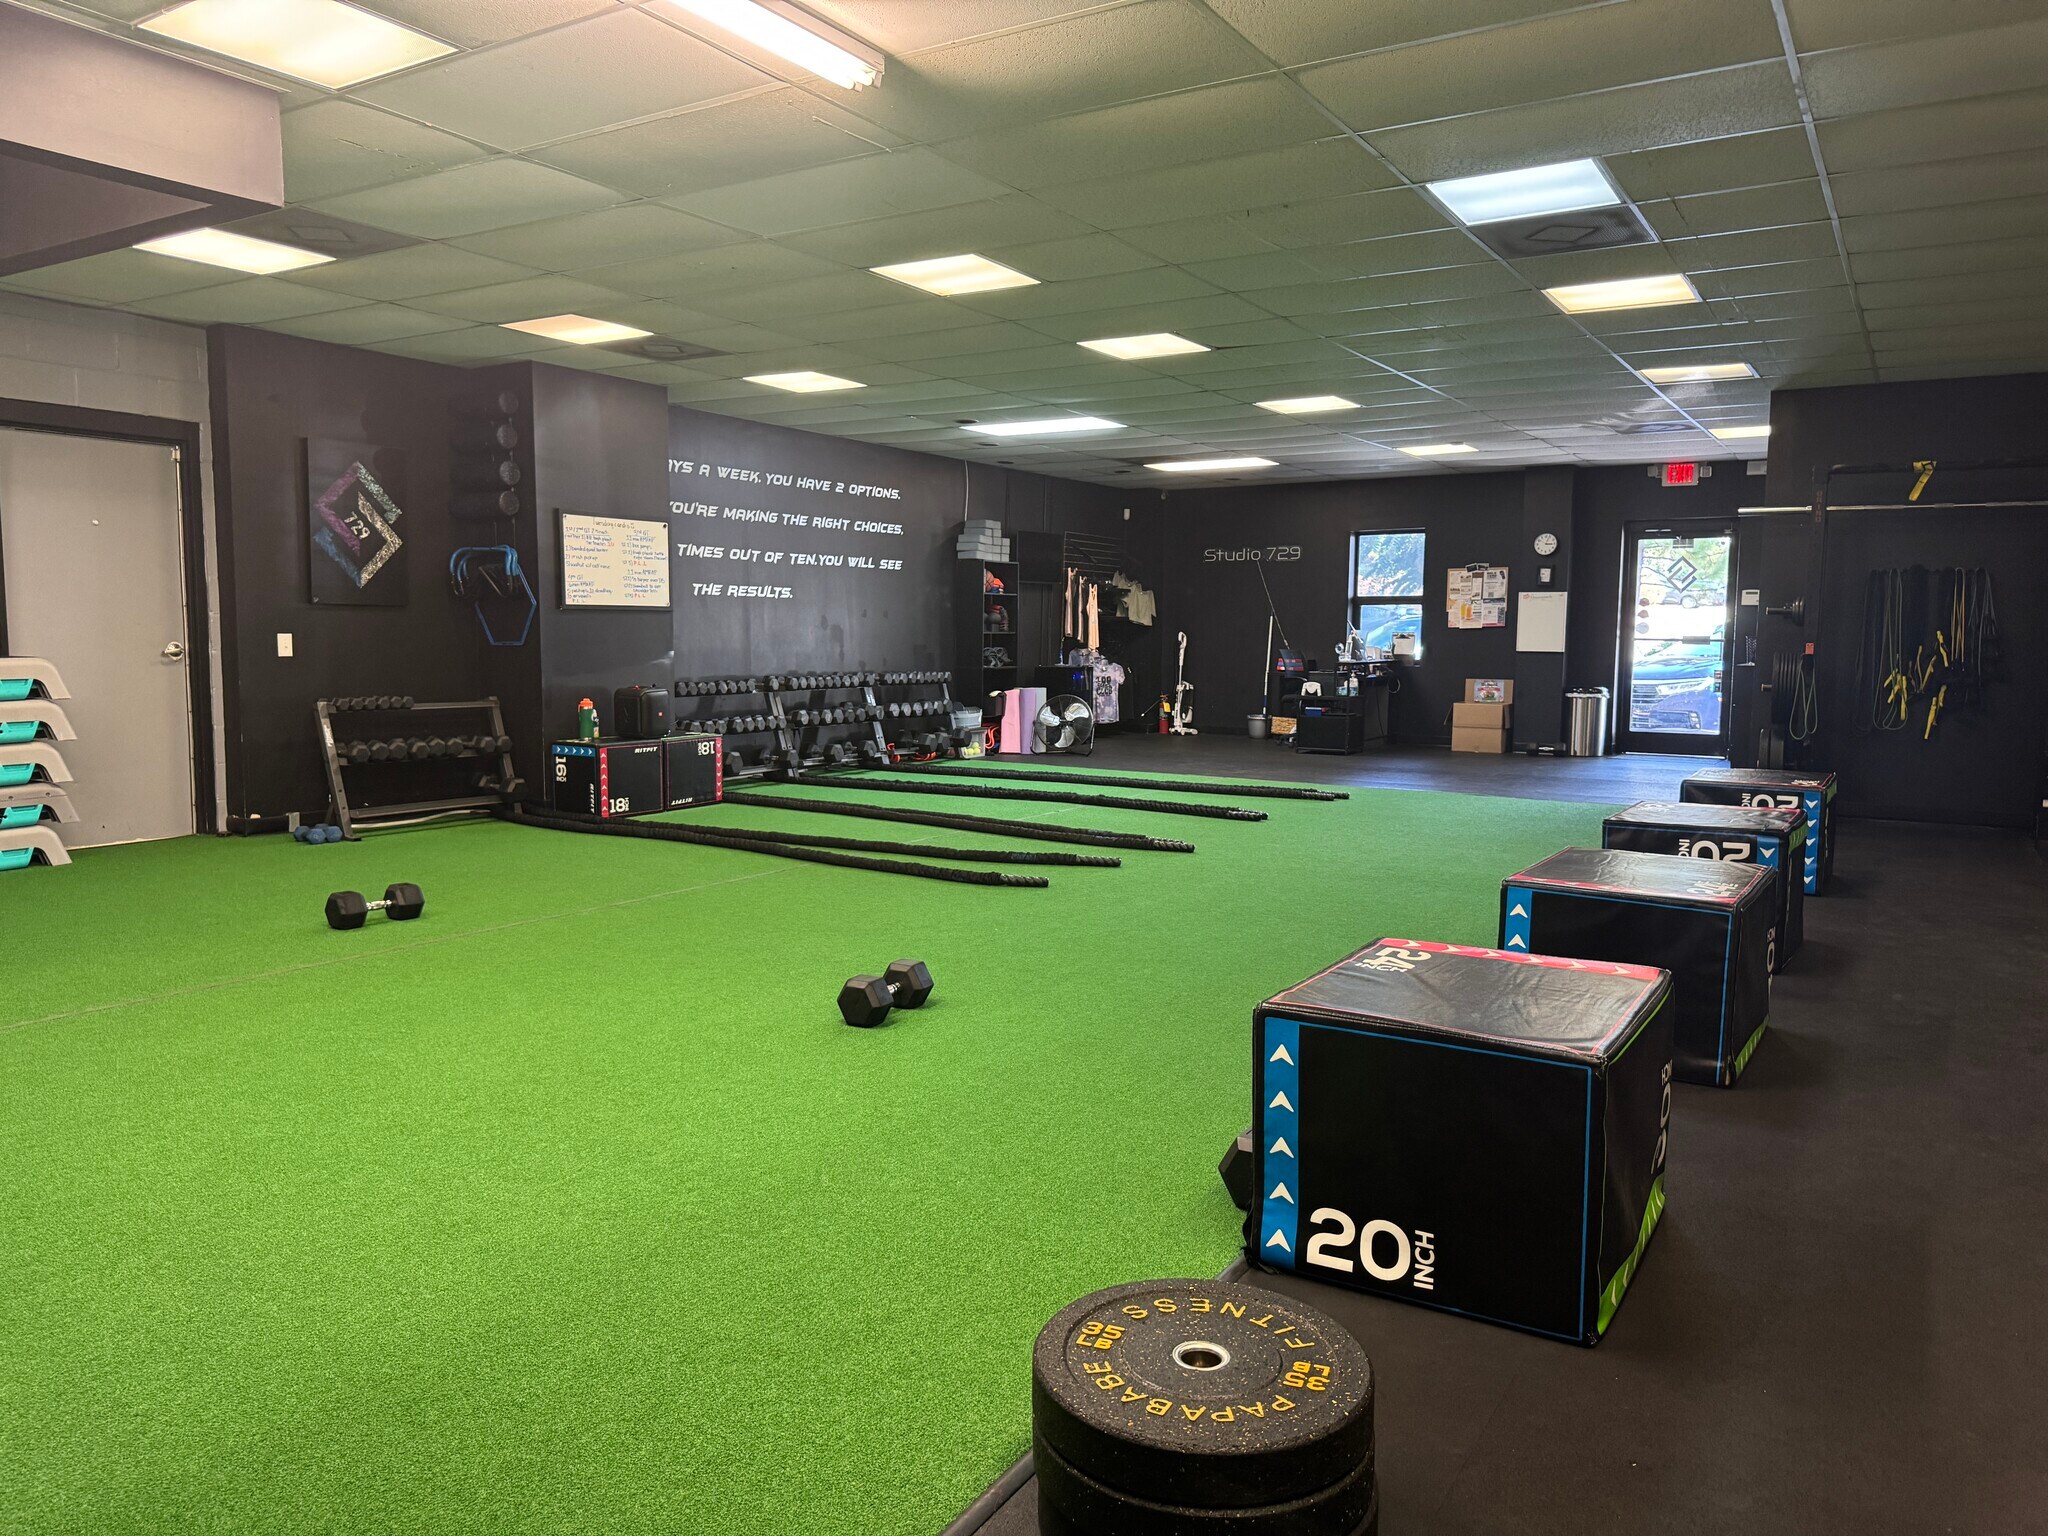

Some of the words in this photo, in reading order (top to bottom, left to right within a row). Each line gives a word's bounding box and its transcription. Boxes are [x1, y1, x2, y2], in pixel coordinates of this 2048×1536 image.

[699, 464, 711, 477] A
[717, 466, 761, 484] WEEK.
[766, 473, 793, 486] YOU
[796, 476, 832, 491] HAVE
[835, 482, 845, 493] 2
[849, 484, 901, 500] OPTIONS.
[1668, 464, 1695, 484] EXIT
[344, 511, 370, 539] 729
[669, 501, 719, 518] OU'RE
[723, 507, 779, 523] MAKING
[782, 513, 809, 526] THE
[812, 516, 851, 531] RIGHT
[854, 520, 904, 536] CHOICES,
[677, 543, 725, 558] TIMES
[729, 548, 762, 563] OUT
[764, 551, 784, 564] OF
[847, 556, 876, 568] WILL
[879, 559, 903, 570] SEE
[1204, 548, 1261, 562] Studio
[1265, 546, 1301, 561] 729
[692, 583, 724, 596] THE
[727, 585, 793, 599] RESULTS.
[700, 741, 715, 756] 18
[555, 756, 567, 777] 16
[609, 797, 626, 813] 18
[1306, 1207, 1411, 1281] 20
[1414, 1229, 1435, 1290] INCH
[1081, 1322, 1126, 1341] 35
[1121, 1298, 1315, 1350] FITNESS
[1076, 1334, 1113, 1350] LB
[1293, 1361, 1331, 1377] LB
[1283, 1372, 1330, 1392] 35
